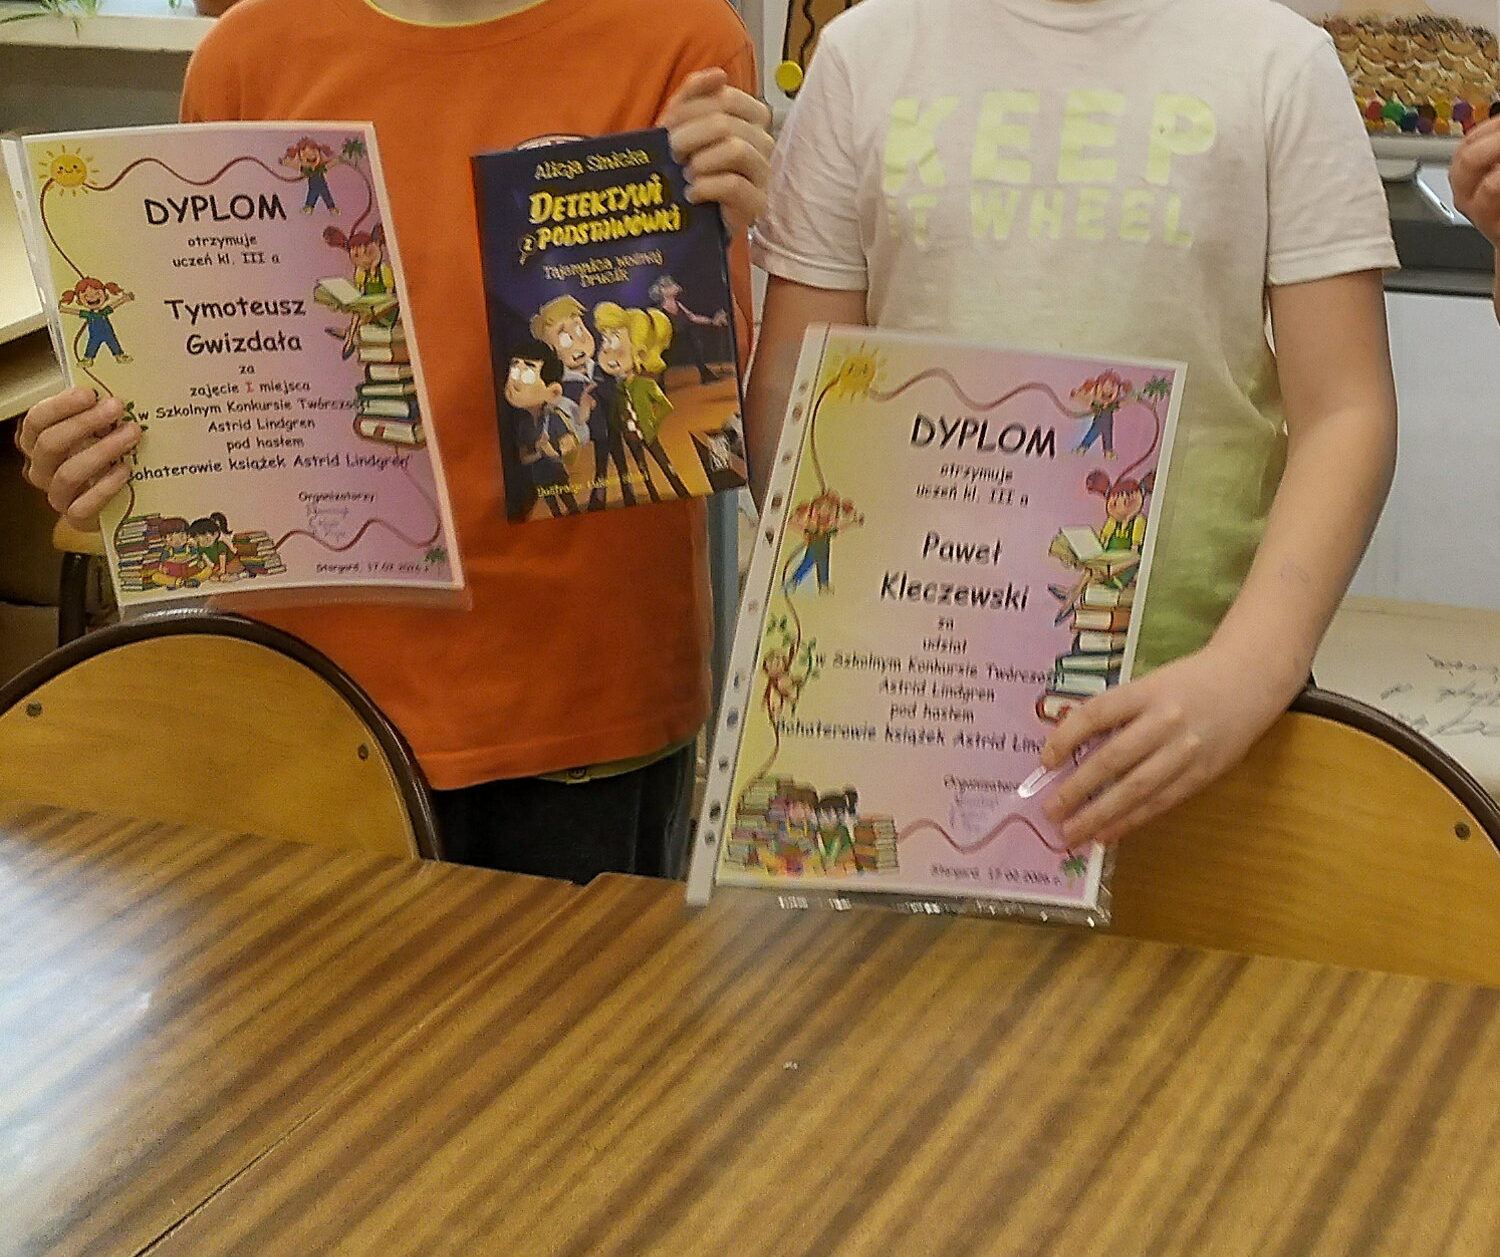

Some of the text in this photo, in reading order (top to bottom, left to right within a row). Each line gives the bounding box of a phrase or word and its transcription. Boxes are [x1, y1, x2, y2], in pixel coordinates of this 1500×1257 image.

[882, 89, 1216, 194] KEEP
[143, 193, 287, 226] DYPLOM
[969, 186, 1195, 251] WHEEL
[187, 232, 258, 249] otrzymuje
[172, 253, 213, 268] uczeń
[241, 251, 265, 265] III
[271, 254, 280, 264] a
[163, 296, 307, 326] Tymoteusz
[186, 329, 303, 355] Gwizdała
[238, 363, 255, 375] za
[189, 380, 311, 399] zajęcie I miejsca
[138, 411, 149, 421] w
[155, 403, 222, 420] Szkolnym
[226, 399, 293, 414] Konkursie
[208, 417, 316, 433] Astrid Lindgren
[909, 412, 1056, 460] DYPLOM
[226, 437, 251, 453] pod
[293, 452, 340, 469] Astrid
[922, 529, 1003, 566] Paweł
[880, 569, 1030, 612] Kleczewski
